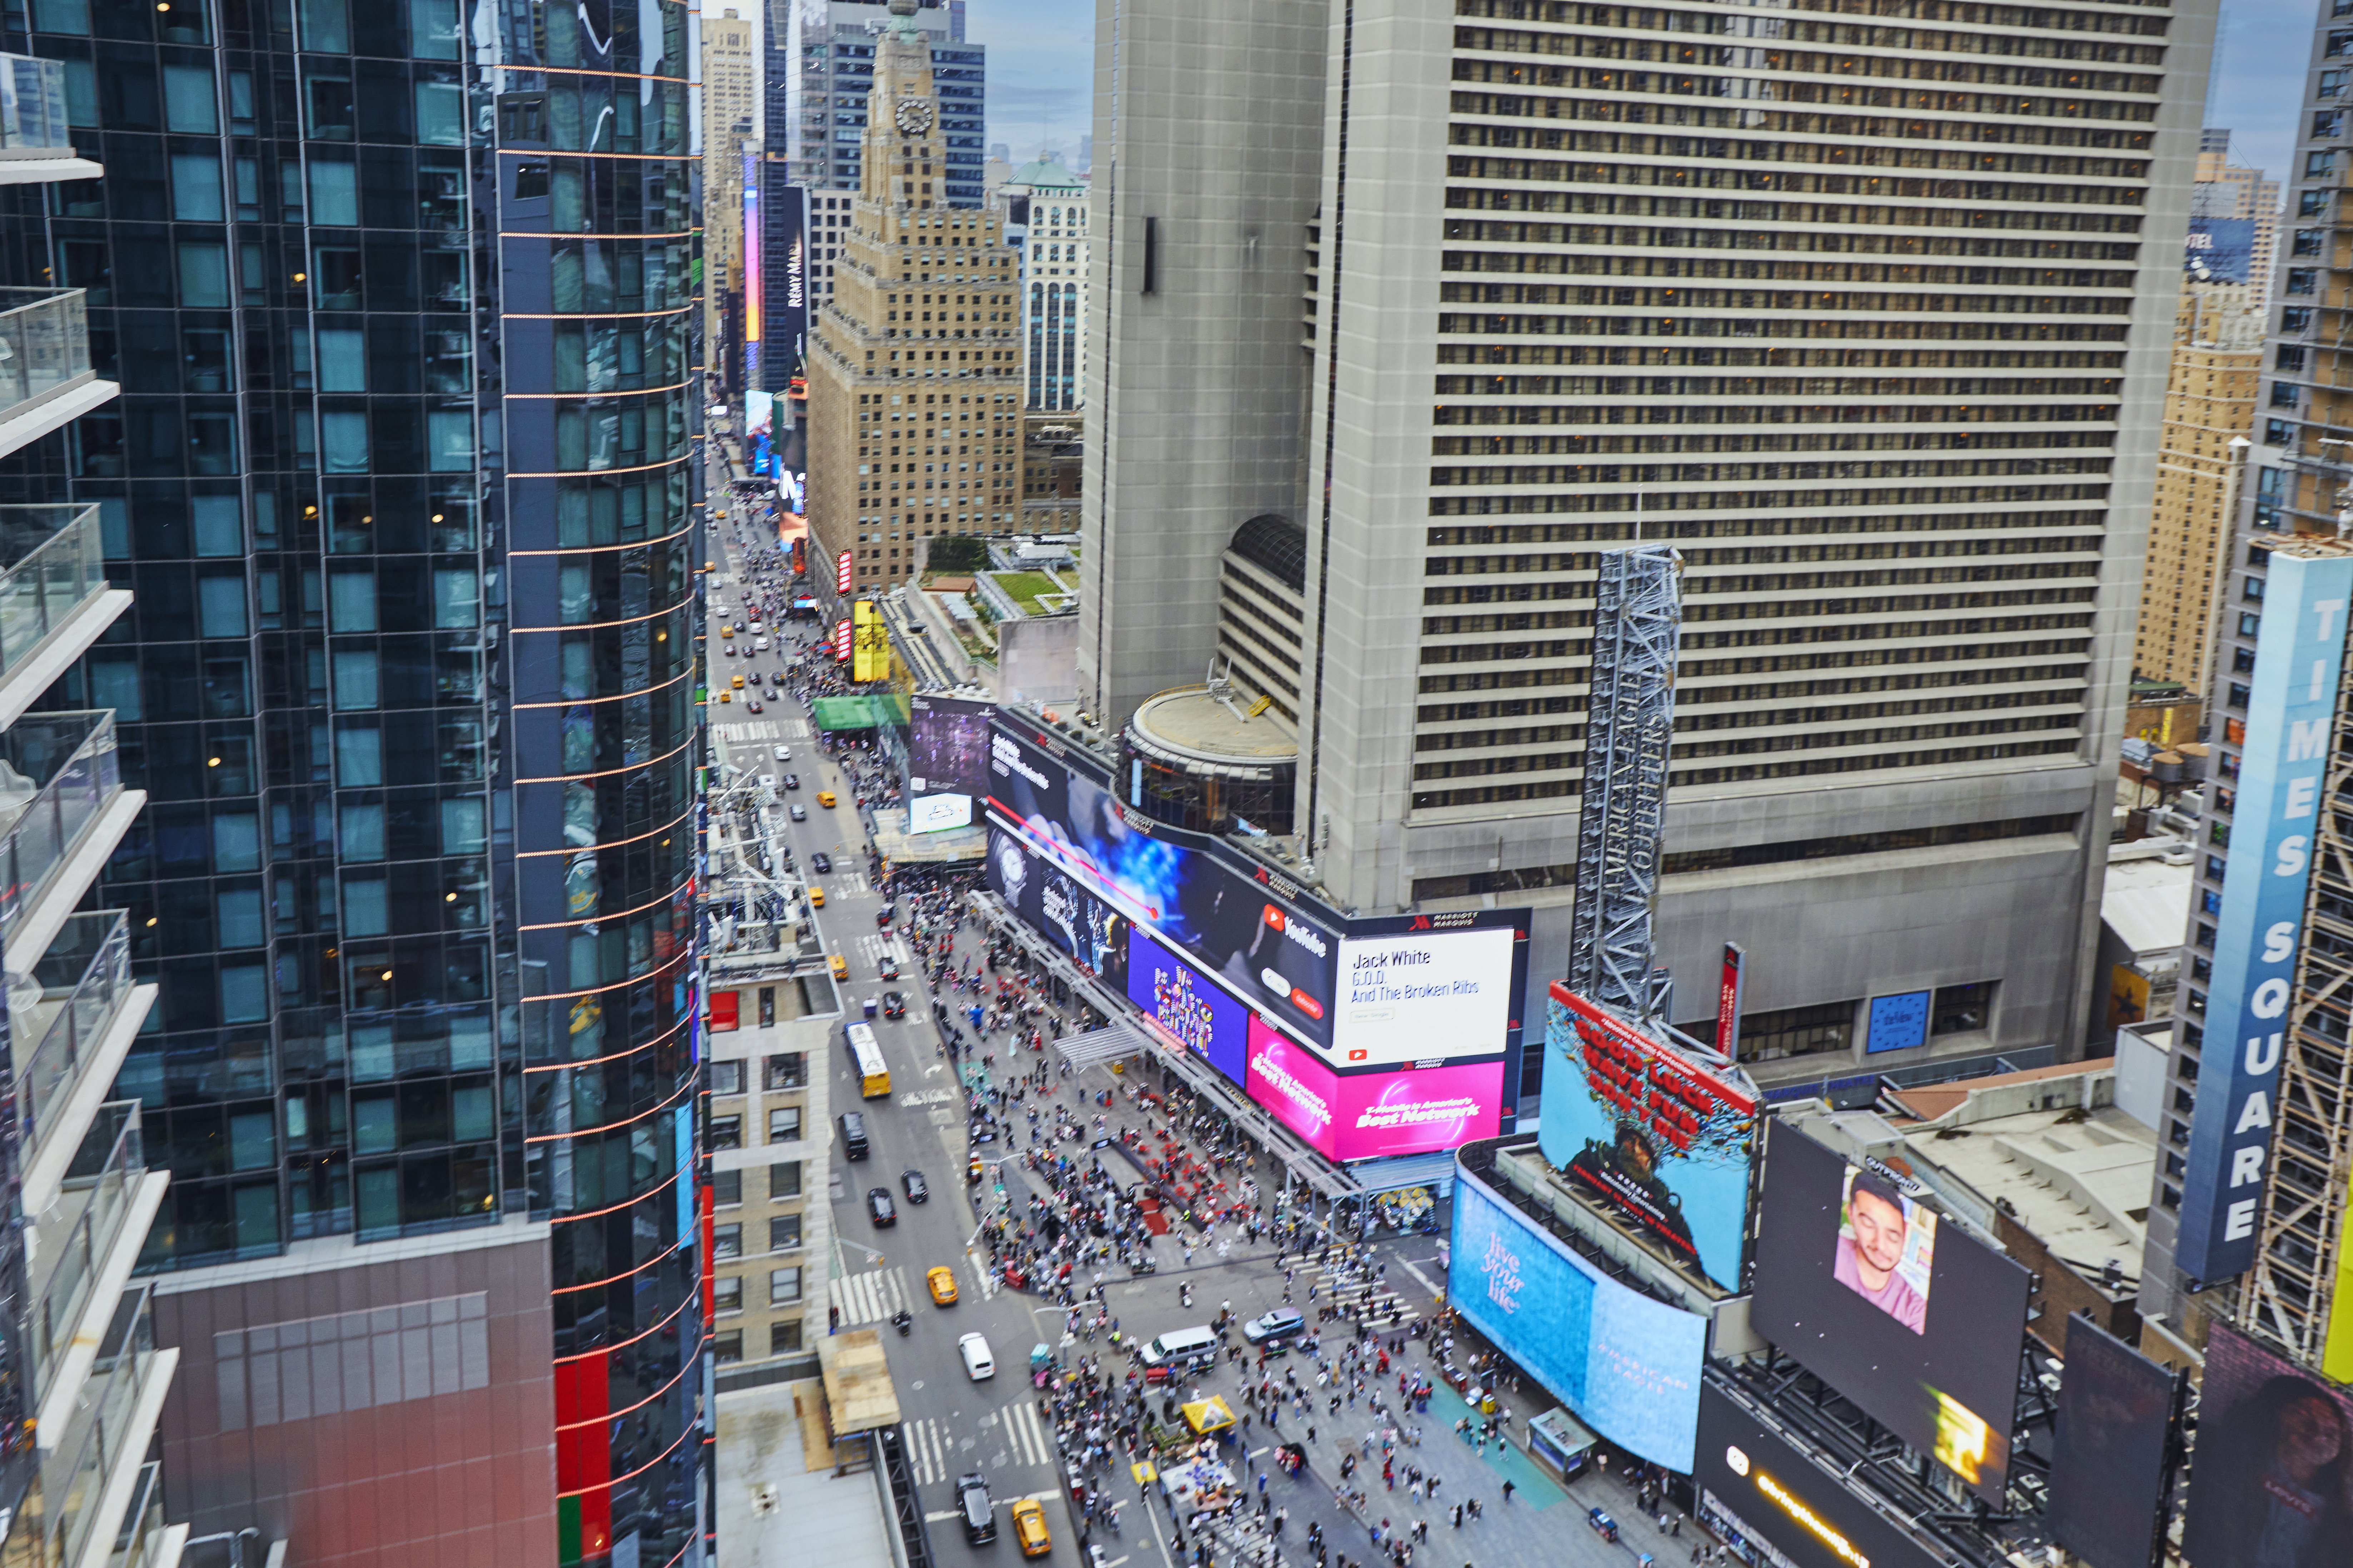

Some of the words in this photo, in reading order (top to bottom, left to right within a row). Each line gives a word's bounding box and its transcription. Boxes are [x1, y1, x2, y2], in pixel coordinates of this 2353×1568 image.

[2273, 599, 2345, 877] TIMES
[1433, 919, 1473, 928] MARQUIS
[1434, 912, 1479, 921] MARRIOTT
[1353, 953, 1388, 969] Jack
[1392, 950, 1431, 966] White
[1351, 988, 1376, 1003] And
[1380, 987, 1401, 1001] The
[1405, 983, 1449, 999] Broken
[1453, 980, 1479, 995] Ribs
[1353, 970, 1387, 986] G.O.D.
[1574, 1019, 1643, 1070] GOOD
[1649, 1062, 1714, 1115] LUCK
[2224, 921, 2295, 1242] SQUARE
[1583, 1043, 1643, 1099] HAVE
[1649, 1090, 1699, 1134] FUN
[1356, 1112, 1401, 1128] Best
[1400, 1103, 1481, 1124] Network
[1654, 1117, 1690, 1152] DIE
[1489, 1232, 1521, 1274] live
[1479, 1253, 1525, 1293] your
[1597, 1343, 1688, 1390] AMERICAN
[1613, 1363, 1665, 1395] EAGLE
